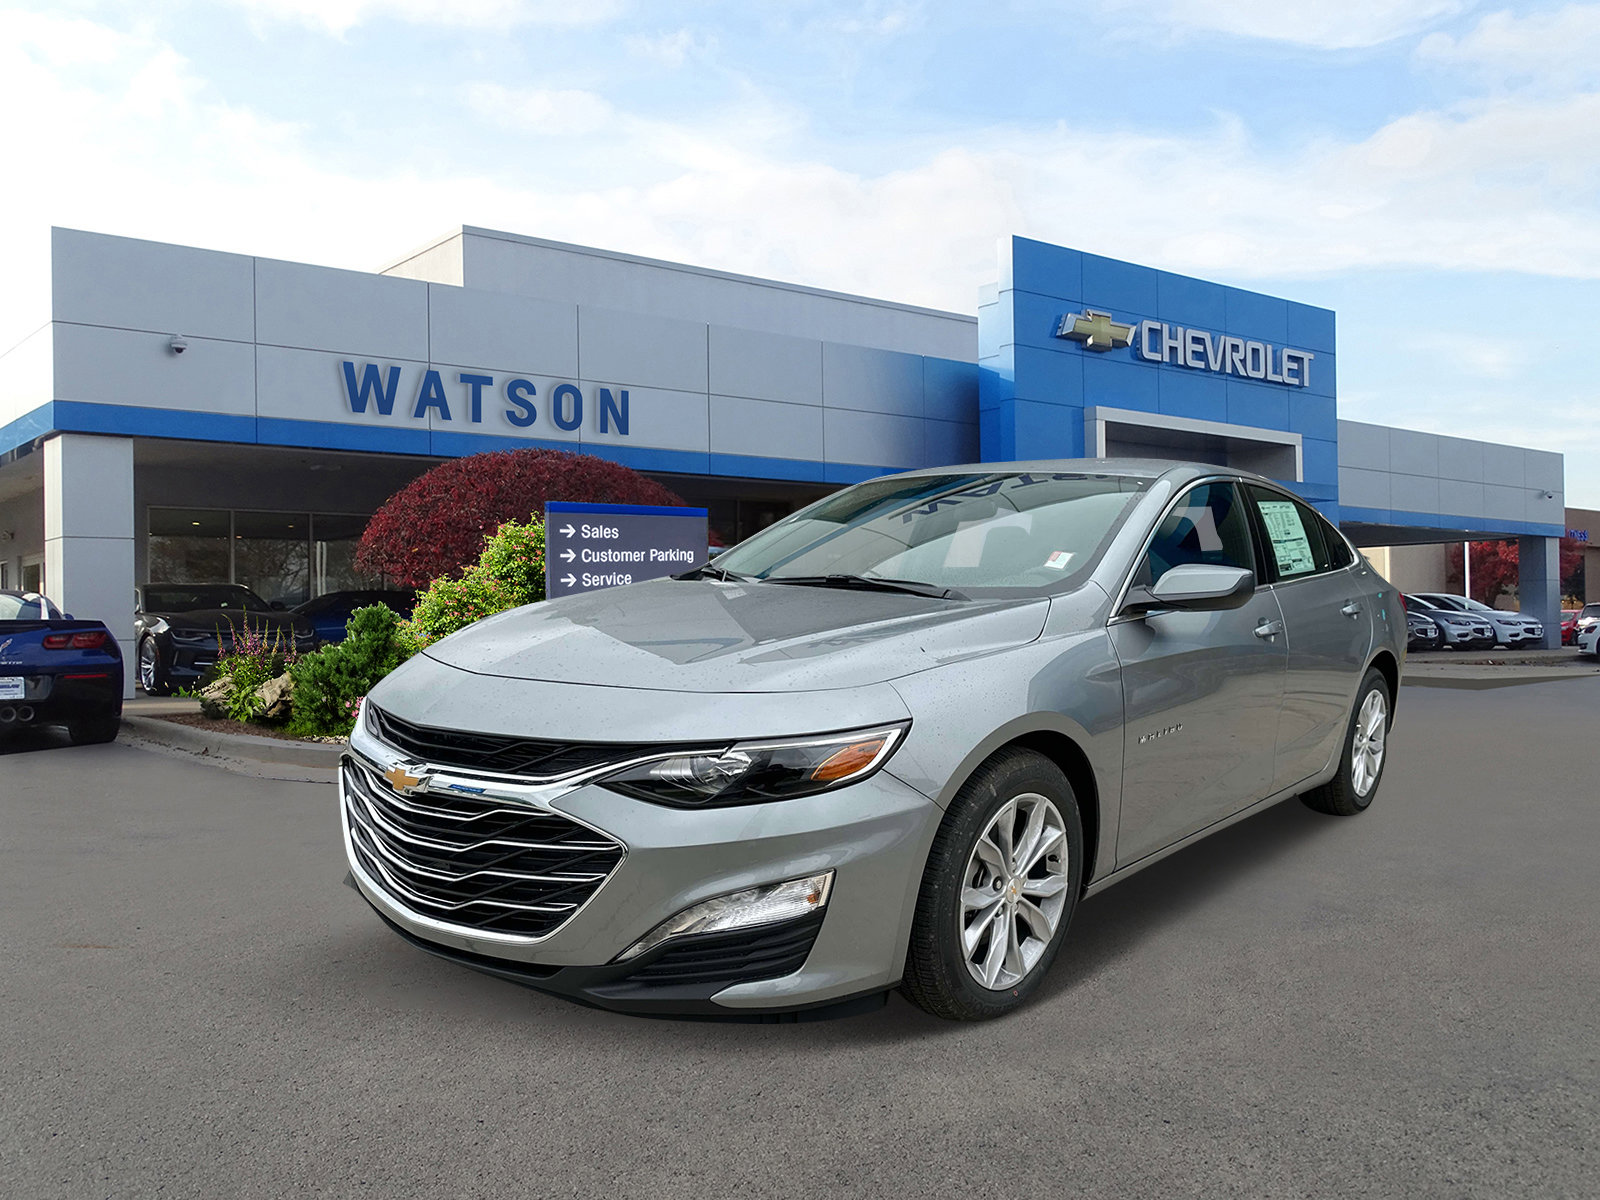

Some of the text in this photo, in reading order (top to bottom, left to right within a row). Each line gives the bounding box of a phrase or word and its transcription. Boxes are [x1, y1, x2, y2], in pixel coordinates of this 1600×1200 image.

[1139, 320, 1314, 387] CHEVROLET
[342, 360, 630, 436] WATSON
[581, 524, 620, 539] Sales
[581, 548, 695, 564] Customer Parking
[582, 572, 633, 587] Service
